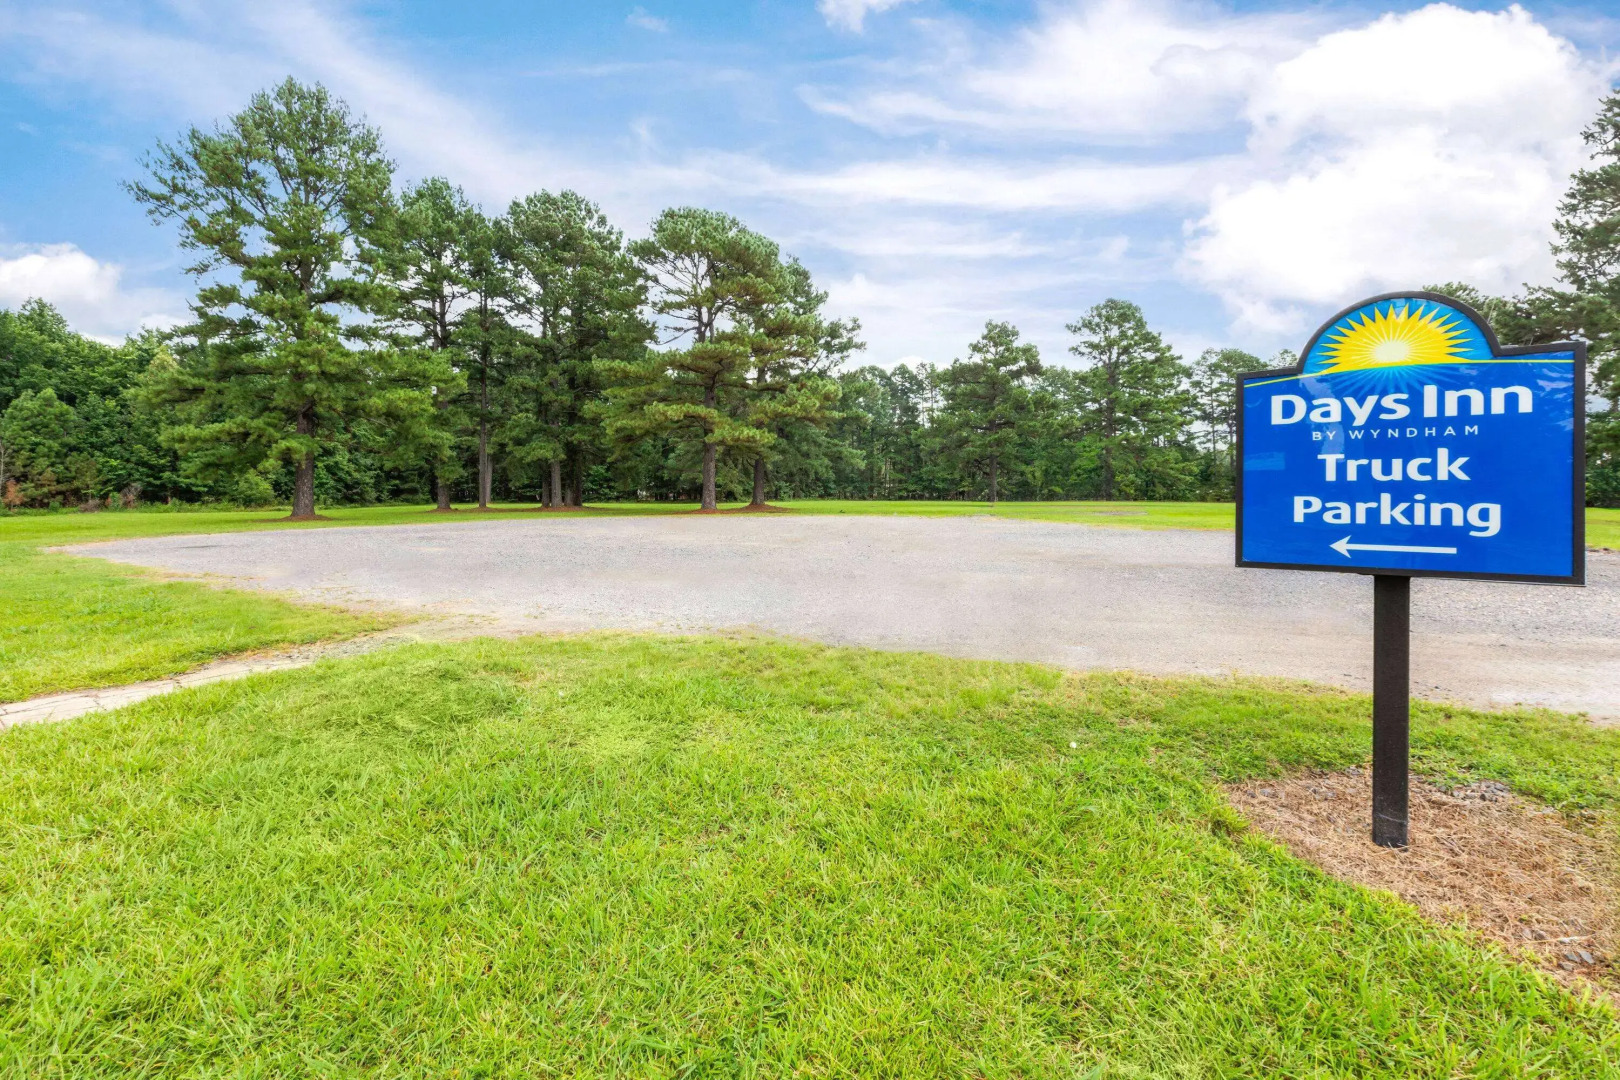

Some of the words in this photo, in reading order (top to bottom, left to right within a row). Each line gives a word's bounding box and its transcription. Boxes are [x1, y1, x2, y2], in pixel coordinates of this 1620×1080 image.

[1271, 393, 1411, 426] Days
[1423, 384, 1533, 418] Inn
[1312, 430, 1336, 441] BY
[1349, 424, 1479, 440] WYNDHAM
[1317, 447, 1471, 482] Truck
[1293, 493, 1502, 537] Parking
